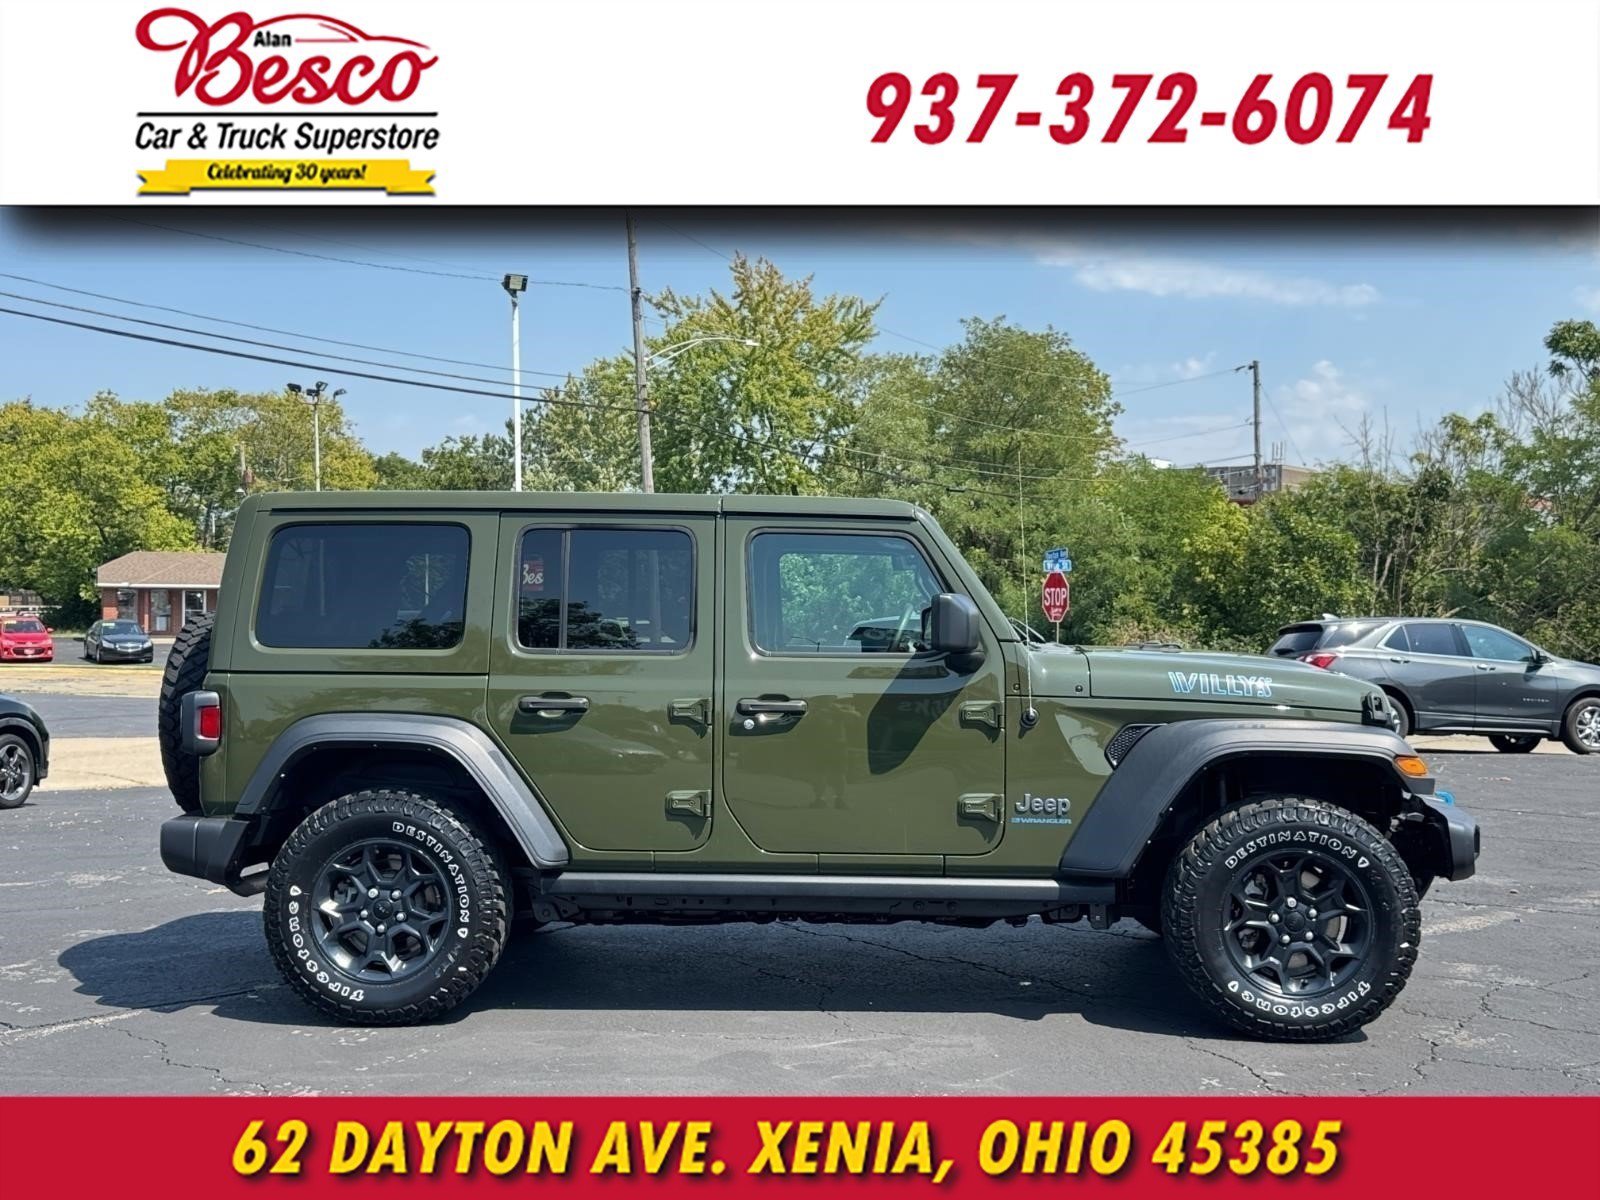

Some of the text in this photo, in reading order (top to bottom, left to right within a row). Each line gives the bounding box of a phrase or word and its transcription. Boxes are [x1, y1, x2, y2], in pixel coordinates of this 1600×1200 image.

[1044, 587, 1067, 606] STOP
[1167, 671, 1273, 698] WILLYS
[1015, 793, 1071, 816] Jeep
[1224, 829, 1358, 869] DESTINATION
[392, 821, 472, 923] DESTINATION
